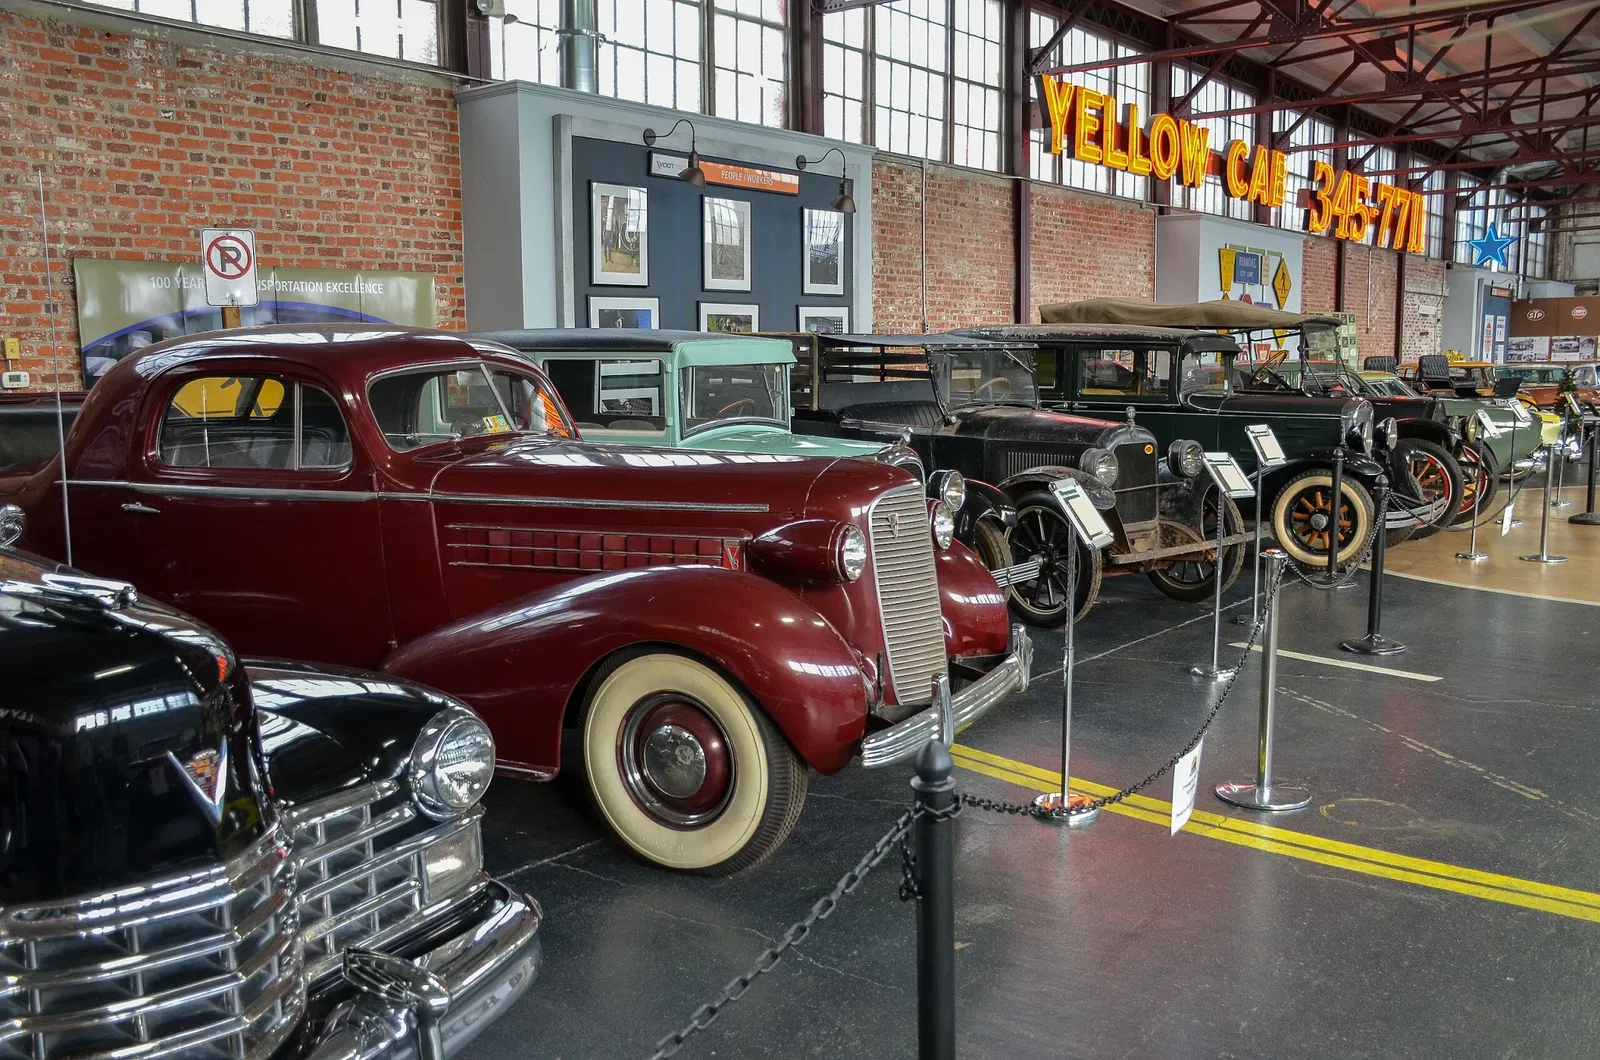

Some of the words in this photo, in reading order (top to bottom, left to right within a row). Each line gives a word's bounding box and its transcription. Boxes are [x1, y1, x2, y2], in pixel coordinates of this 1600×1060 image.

[1042, 74, 1210, 189] YELLOW
[1226, 138, 1288, 207] CAB
[1308, 159, 1426, 254] 345-7711
[721, 170, 742, 181] PEOPLE
[747, 173, 774, 186] WORKERS
[149, 275, 171, 289] 100
[174, 276, 205, 289] YEAR
[257, 279, 323, 294] SPORTATION
[326, 281, 384, 295] EXCELLENCE
[1529, 309, 1543, 319] STP
